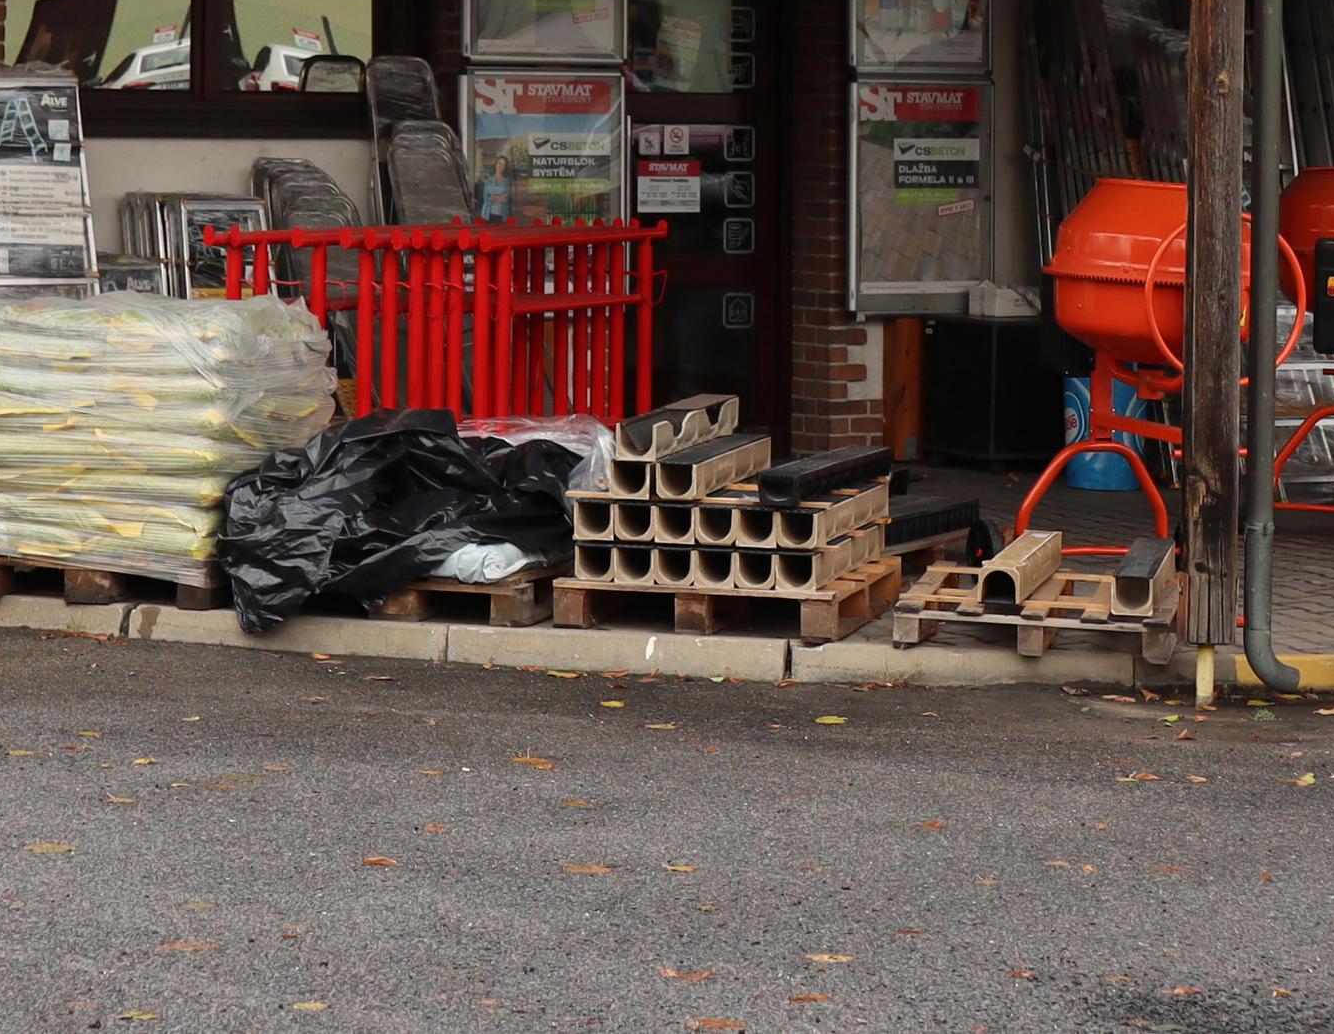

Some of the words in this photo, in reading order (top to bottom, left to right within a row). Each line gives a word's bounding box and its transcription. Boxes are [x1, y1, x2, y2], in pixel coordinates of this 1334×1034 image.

[527, 83, 593, 96] STAVMAT
[906, 91, 964, 104] STAVMAT
[532, 157, 596, 166] NATURBLOK
[532, 166, 576, 177] SYSTÉM
[898, 163, 938, 174] DLAŽBA
[898, 175, 947, 184] FORMELA
